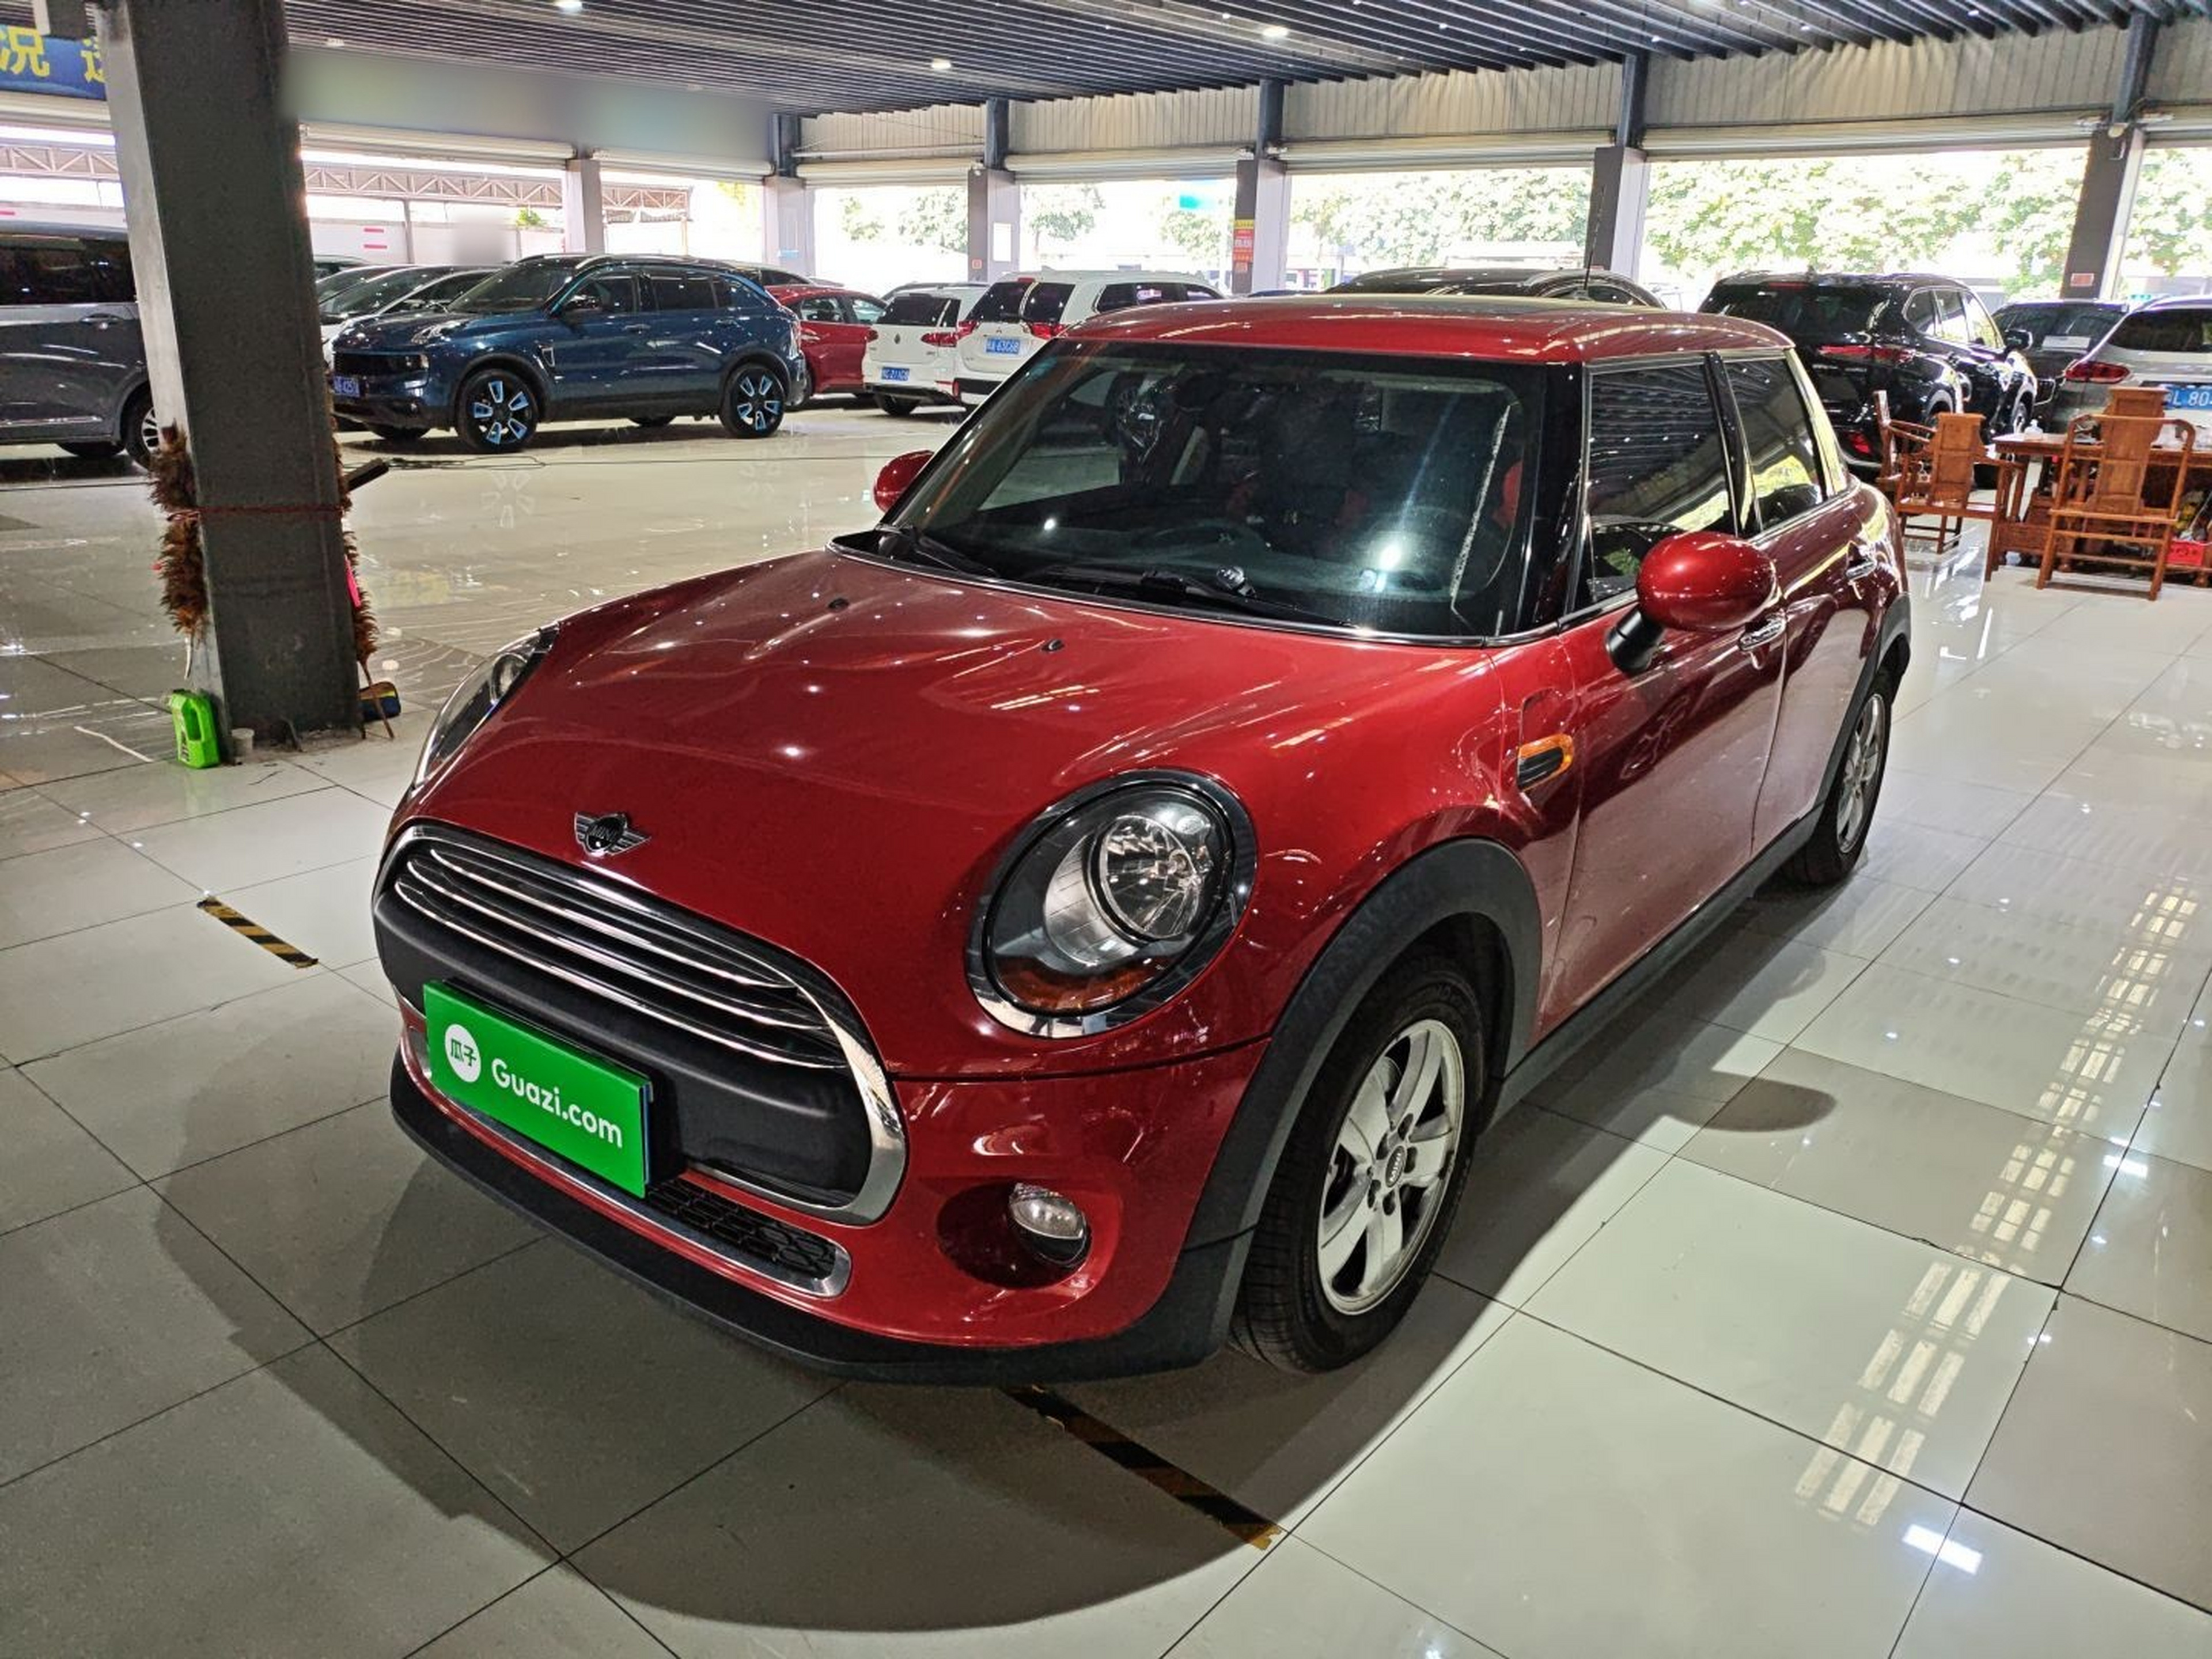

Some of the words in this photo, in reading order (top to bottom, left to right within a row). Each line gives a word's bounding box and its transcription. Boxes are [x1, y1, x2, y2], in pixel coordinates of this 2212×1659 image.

[587, 824, 618, 842] MINI
[450, 1038, 477, 1067] 瓜子
[491, 1058, 623, 1148] Guazi.com
[1389, 1153, 1402, 1182] MINI
